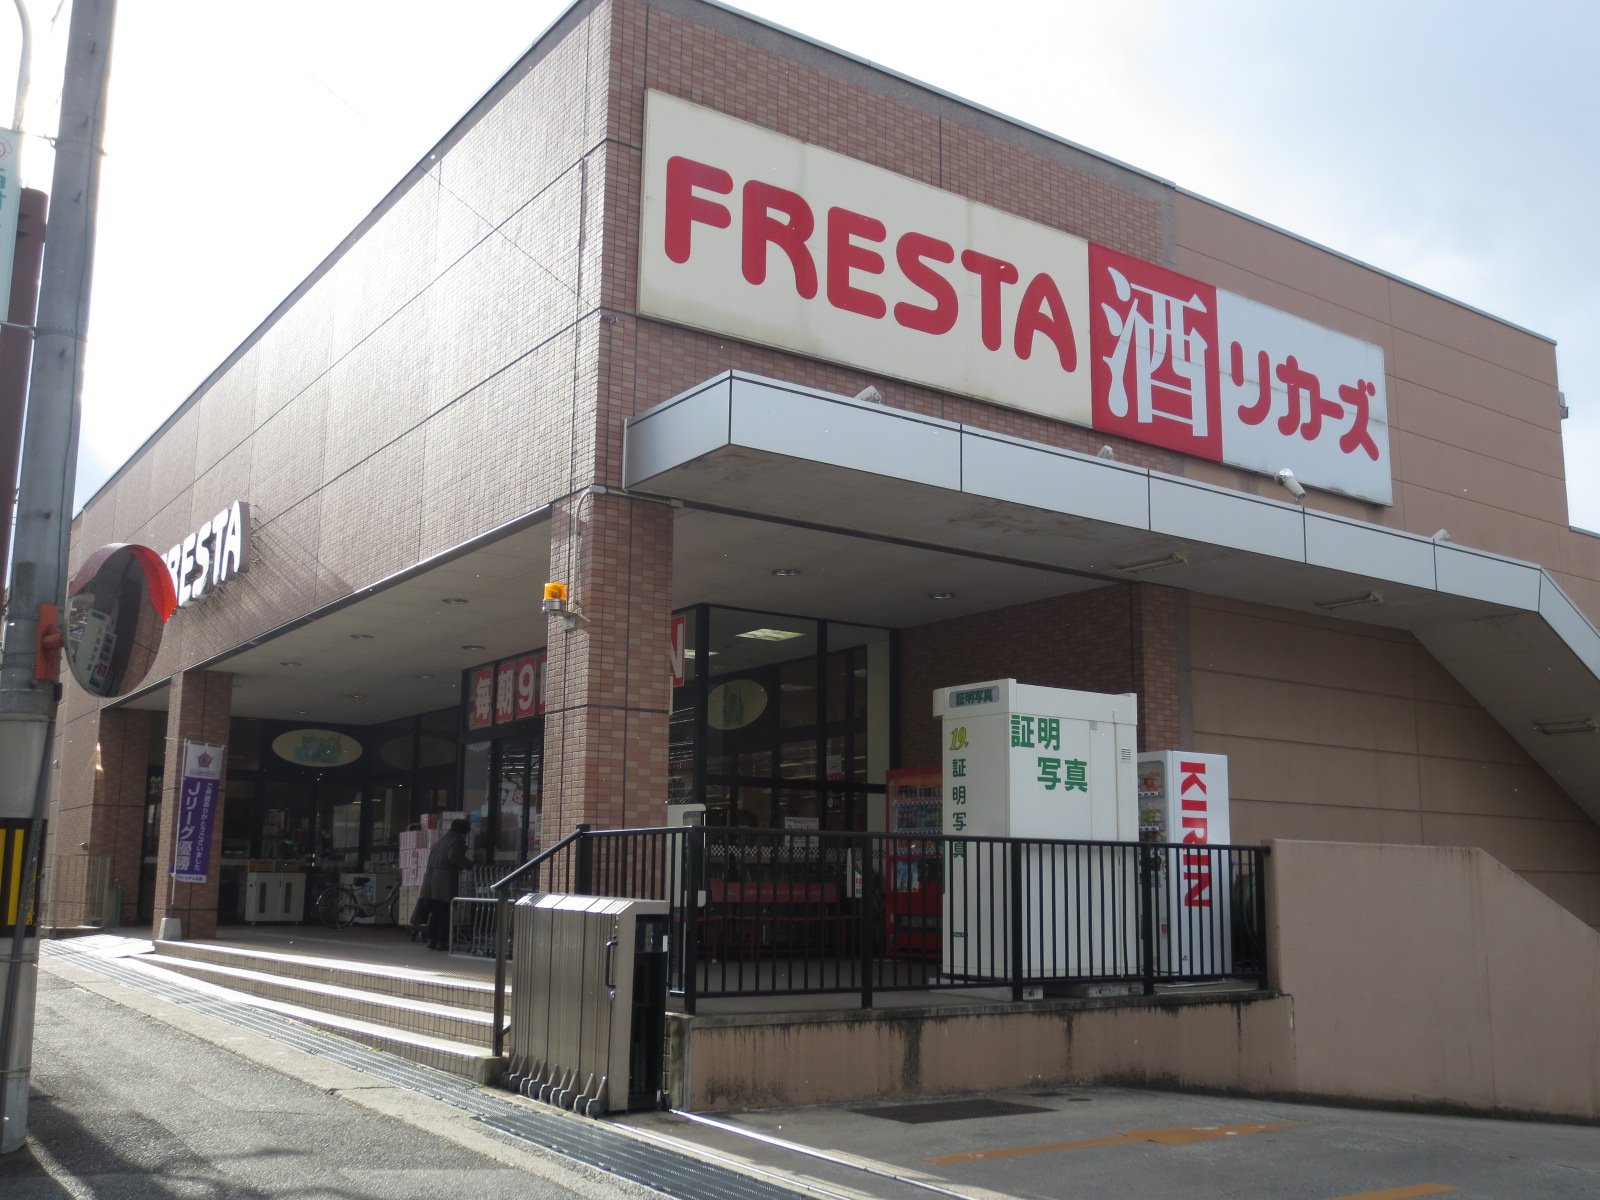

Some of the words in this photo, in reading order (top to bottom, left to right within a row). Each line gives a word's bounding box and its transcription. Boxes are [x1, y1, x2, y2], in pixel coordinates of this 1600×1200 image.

[664, 155, 1078, 373] FRESTA
[1100, 265, 1208, 437] 酒
[1230, 340, 1380, 462] リカーズ
[161, 499, 242, 607] RESTA
[955, 688, 993, 706] 証明写真
[1010, 714, 1061, 752] 証明
[175, 781, 201, 871] Jリーグ優勝
[952, 758, 967, 859] 証明写真
[1037, 756, 1089, 793] 写真
[1180, 760, 1213, 908] KIRIN
